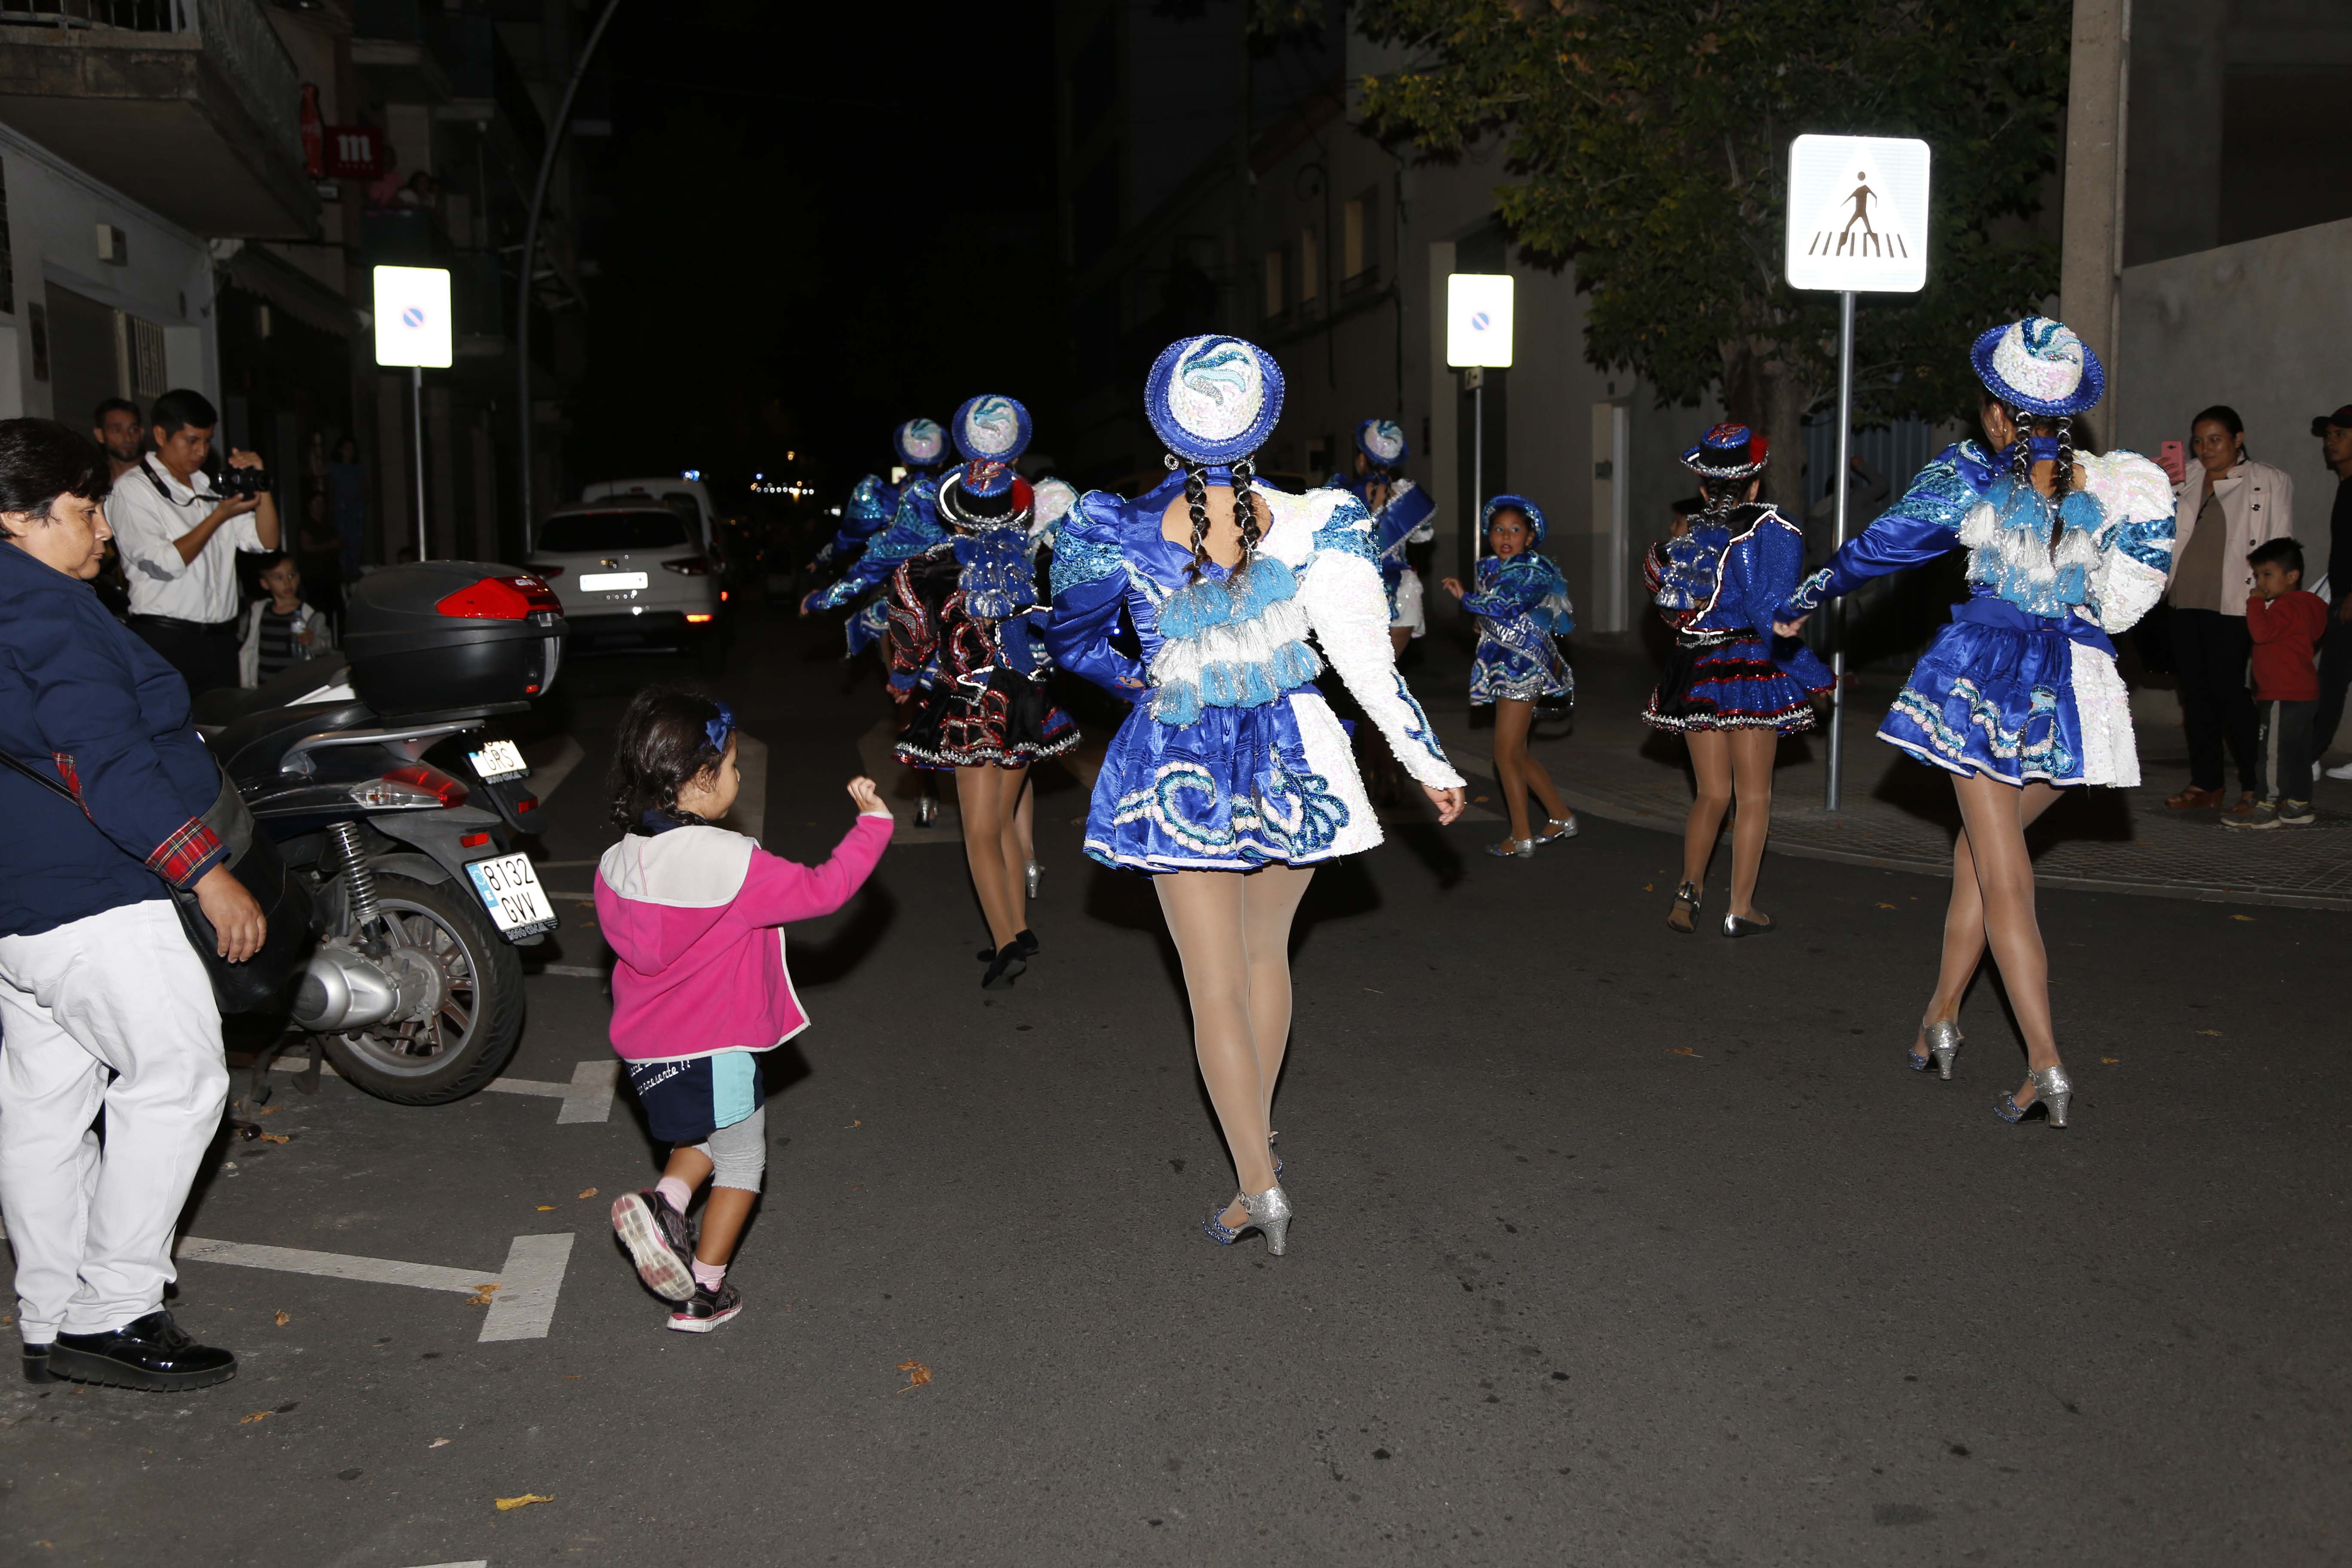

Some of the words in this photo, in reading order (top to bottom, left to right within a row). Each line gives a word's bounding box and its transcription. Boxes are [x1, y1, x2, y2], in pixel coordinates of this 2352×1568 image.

[483, 747, 514, 770] GRS
[484, 858, 534, 891] 8132
[502, 892, 536, 923] GVV
[506, 928, 527, 940] MOTO
